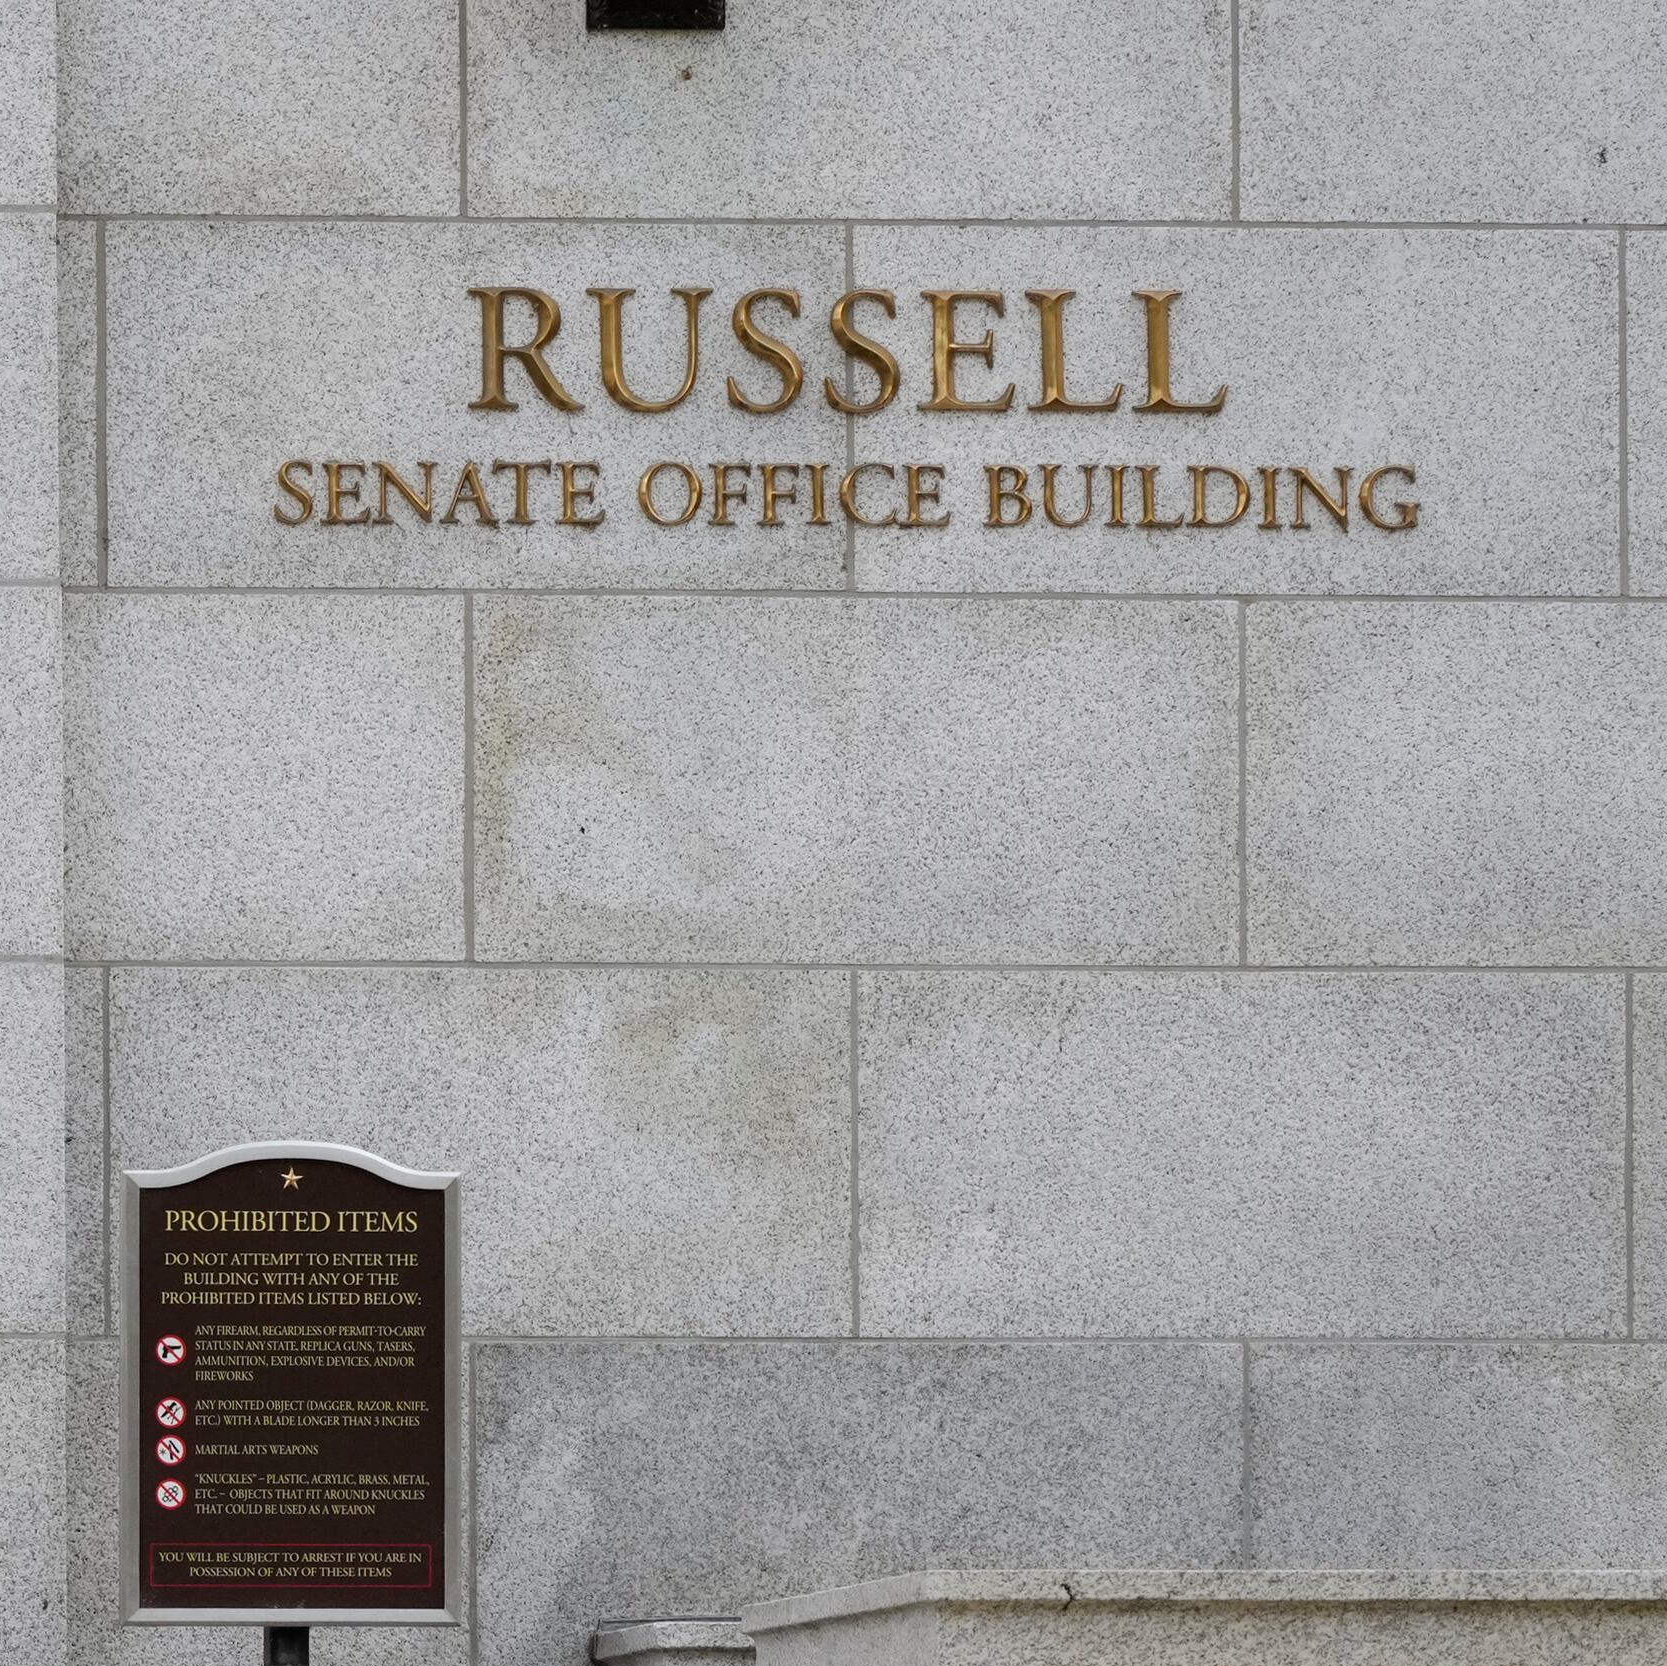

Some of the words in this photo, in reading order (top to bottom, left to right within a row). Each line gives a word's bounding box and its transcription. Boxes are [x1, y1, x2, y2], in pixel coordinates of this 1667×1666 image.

[468, 286, 1227, 414] RUSSELL
[273, 459, 606, 530] SENATE
[637, 461, 951, 530] OFFICE
[982, 463, 1420, 532] BUILDING
[164, 1209, 331, 1233] PROHIBITED
[337, 1210, 418, 1233] ITEMS
[164, 1252, 190, 1266] DO
[192, 1252, 229, 1266] NOT
[230, 1252, 304, 1266] ATTEMPT
[305, 1252, 330, 1266] TO
[332, 1253, 384, 1267] ENTER
[385, 1253, 419, 1267] THE
[183, 1271, 259, 1286] BUILDING
[261, 1272, 305, 1286] WITH
[308, 1272, 341, 1286] ANY
[342, 1272, 364, 1286] OF
[366, 1272, 400, 1286] THE
[161, 1291, 256, 1305] PROHIBITED
[258, 1291, 305, 1306] ITEMS
[307, 1292, 361, 1306] LISTED
[363, 1292, 422, 1306] BELOW:
[194, 1325, 216, 1336] ANY
[216, 1325, 262, 1336] FIREARM,
[262, 1325, 323, 1337] REGARDLESS
[322, 1325, 338, 1336] OF
[338, 1325, 427, 1337] PERMIT-TO-CARRY
[194, 1339, 232, 1351] STATUS
[232, 1340, 244, 1351] IN
[245, 1340, 266, 1351] ANY
[266, 1340, 299, 1352] STATE,
[300, 1340, 342, 1352] REPLICA
[342, 1340, 375, 1353] GUNS,
[376, 1341, 416, 1352] TASERS,
[194, 1355, 269, 1367] AMMUNITION,
[270, 1355, 325, 1367] EXPLOSIVE
[326, 1355, 372, 1368] DEVICES,
[373, 1356, 415, 1367] AND/OR
[195, 1370, 254, 1381] FIREWORKS
[194, 1399, 217, 1411] ANY
[218, 1399, 265, 1411] POINTED
[265, 1399, 305, 1413] OBJECT
[306, 1399, 355, 1412] (DAGGER,
[357, 1400, 395, 1412] RAZOR,
[396, 1400, 429, 1412] KNIFE,
[195, 1414, 221, 1426] ETC.)
[223, 1414, 252, 1426] WITH
[253, 1415, 261, 1426] A
[262, 1415, 296, 1426] BLADE
[297, 1415, 341, 1426] LONGER
[341, 1415, 372, 1427] THAN
[373, 1416, 380, 1427] 3
[381, 1415, 420, 1427] INCHES
[194, 1444, 241, 1455] MARTIAL
[241, 1444, 268, 1455] ARTS
[269, 1444, 319, 1456] WEAPONS
[266, 1473, 310, 1485] PLASTIC,
[310, 1473, 357, 1485] ACRYLIC,
[358, 1474, 391, 1485] BRASS,
[392, 1474, 430, 1486] METAL,
[194, 1488, 218, 1500] ETC.
[229, 1488, 274, 1501] OBJECTS
[274, 1488, 305, 1500] THAT
[305, 1488, 323, 1500] FIT
[323, 1488, 370, 1501] AROUND
[371, 1489, 425, 1501] KNUCKLES
[194, 1503, 224, 1515] THAT
[224, 1503, 263, 1515] COULD
[264, 1503, 278, 1515] BE
[279, 1503, 307, 1515] USED
[308, 1504, 321, 1515] AS
[321, 1504, 330, 1515] A
[330, 1504, 376, 1515] WEAPON
[158, 1551, 184, 1562] YOU
[185, 1552, 215, 1563] WILL
[216, 1552, 231, 1563] BE
[231, 1552, 280, 1563] SUBJECT
[281, 1552, 300, 1563] TO
[301, 1552, 344, 1563] ARREST
[345, 1552, 356, 1563] IF
[357, 1552, 383, 1563] YOU
[384, 1552, 407, 1563] ARE
[408, 1552, 422, 1563] IN
[189, 1566, 256, 1577] POSSESSION
[257, 1566, 274, 1577] OF
[275, 1566, 300, 1577] ANY
[300, 1566, 318, 1577] OF
[318, 1566, 356, 1577] THESE
[357, 1567, 392, 1578] ITEMS
